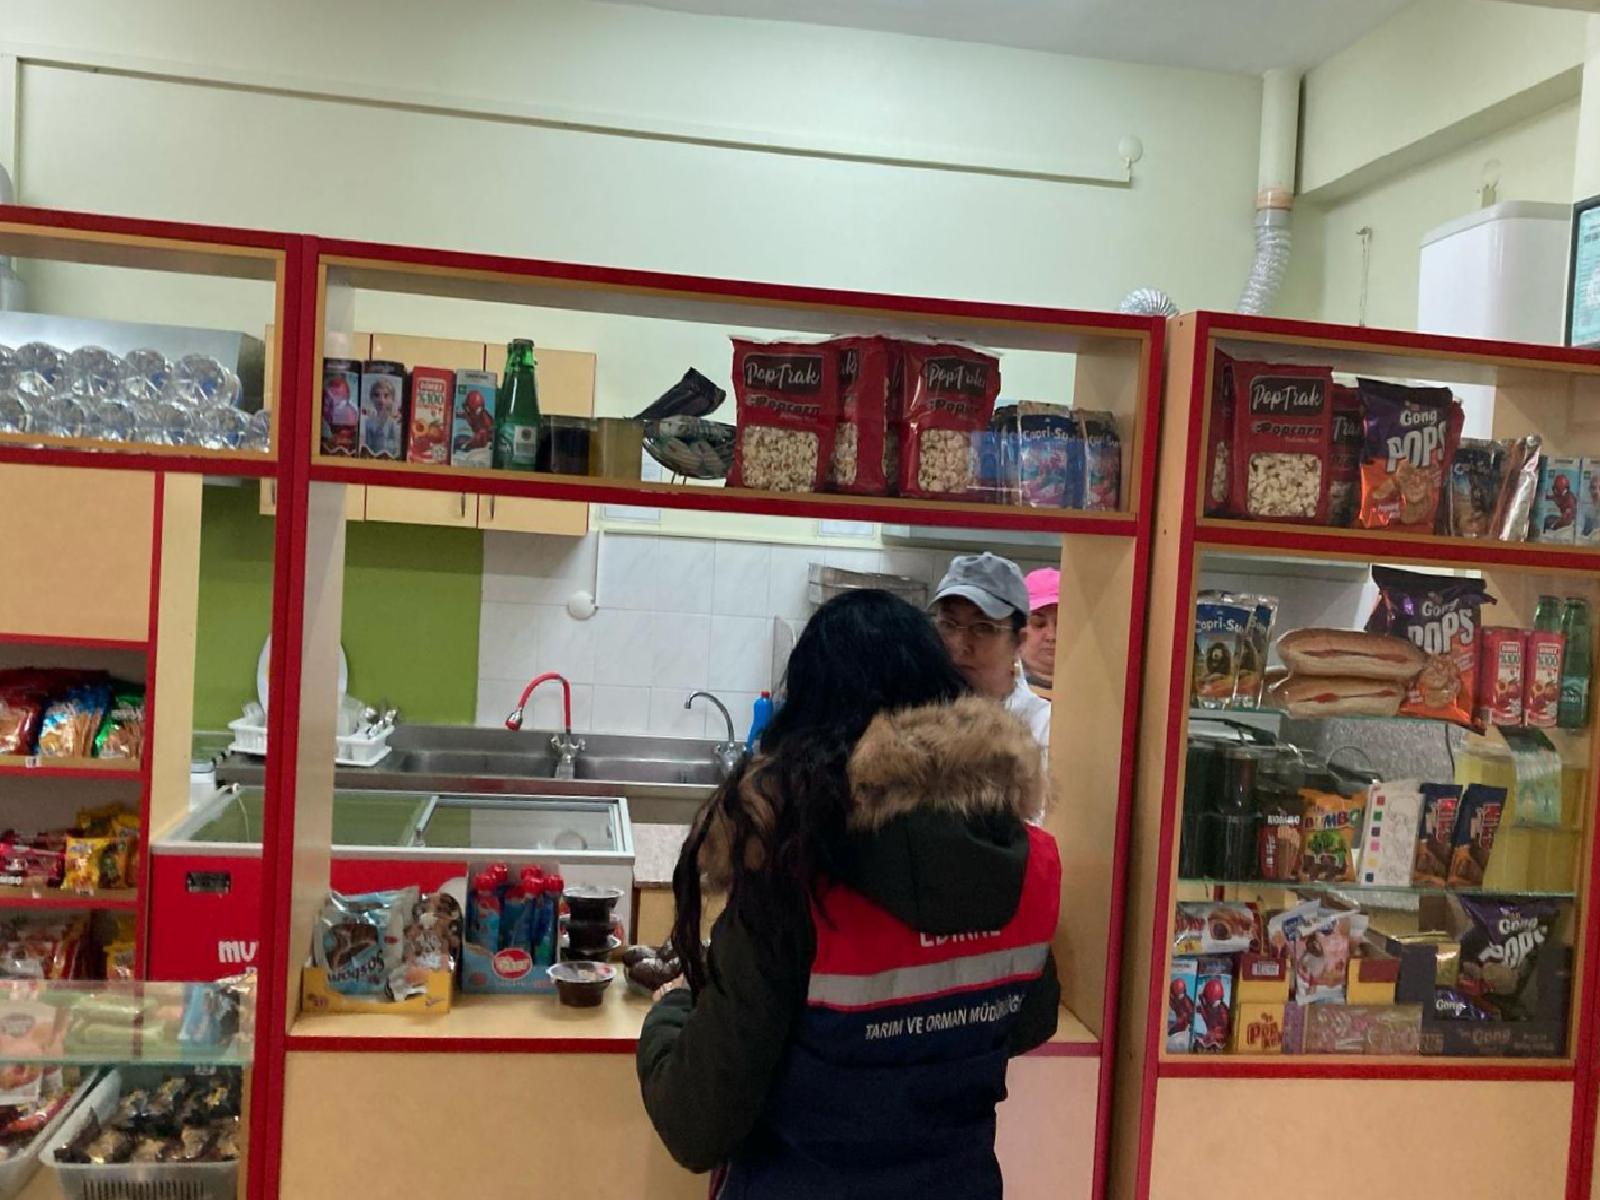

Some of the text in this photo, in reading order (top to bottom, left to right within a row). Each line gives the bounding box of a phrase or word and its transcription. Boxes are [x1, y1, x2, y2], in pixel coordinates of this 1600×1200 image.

[744, 361, 820, 389] PopTrak
[1252, 383, 1321, 411] PopTrak
[1400, 409, 1438, 426] Gong
[1386, 420, 1447, 473] POPS
[865, 1022, 903, 1040] TARIM
[907, 1016, 924, 1034] VE
[926, 1008, 967, 1032] ORMAN
